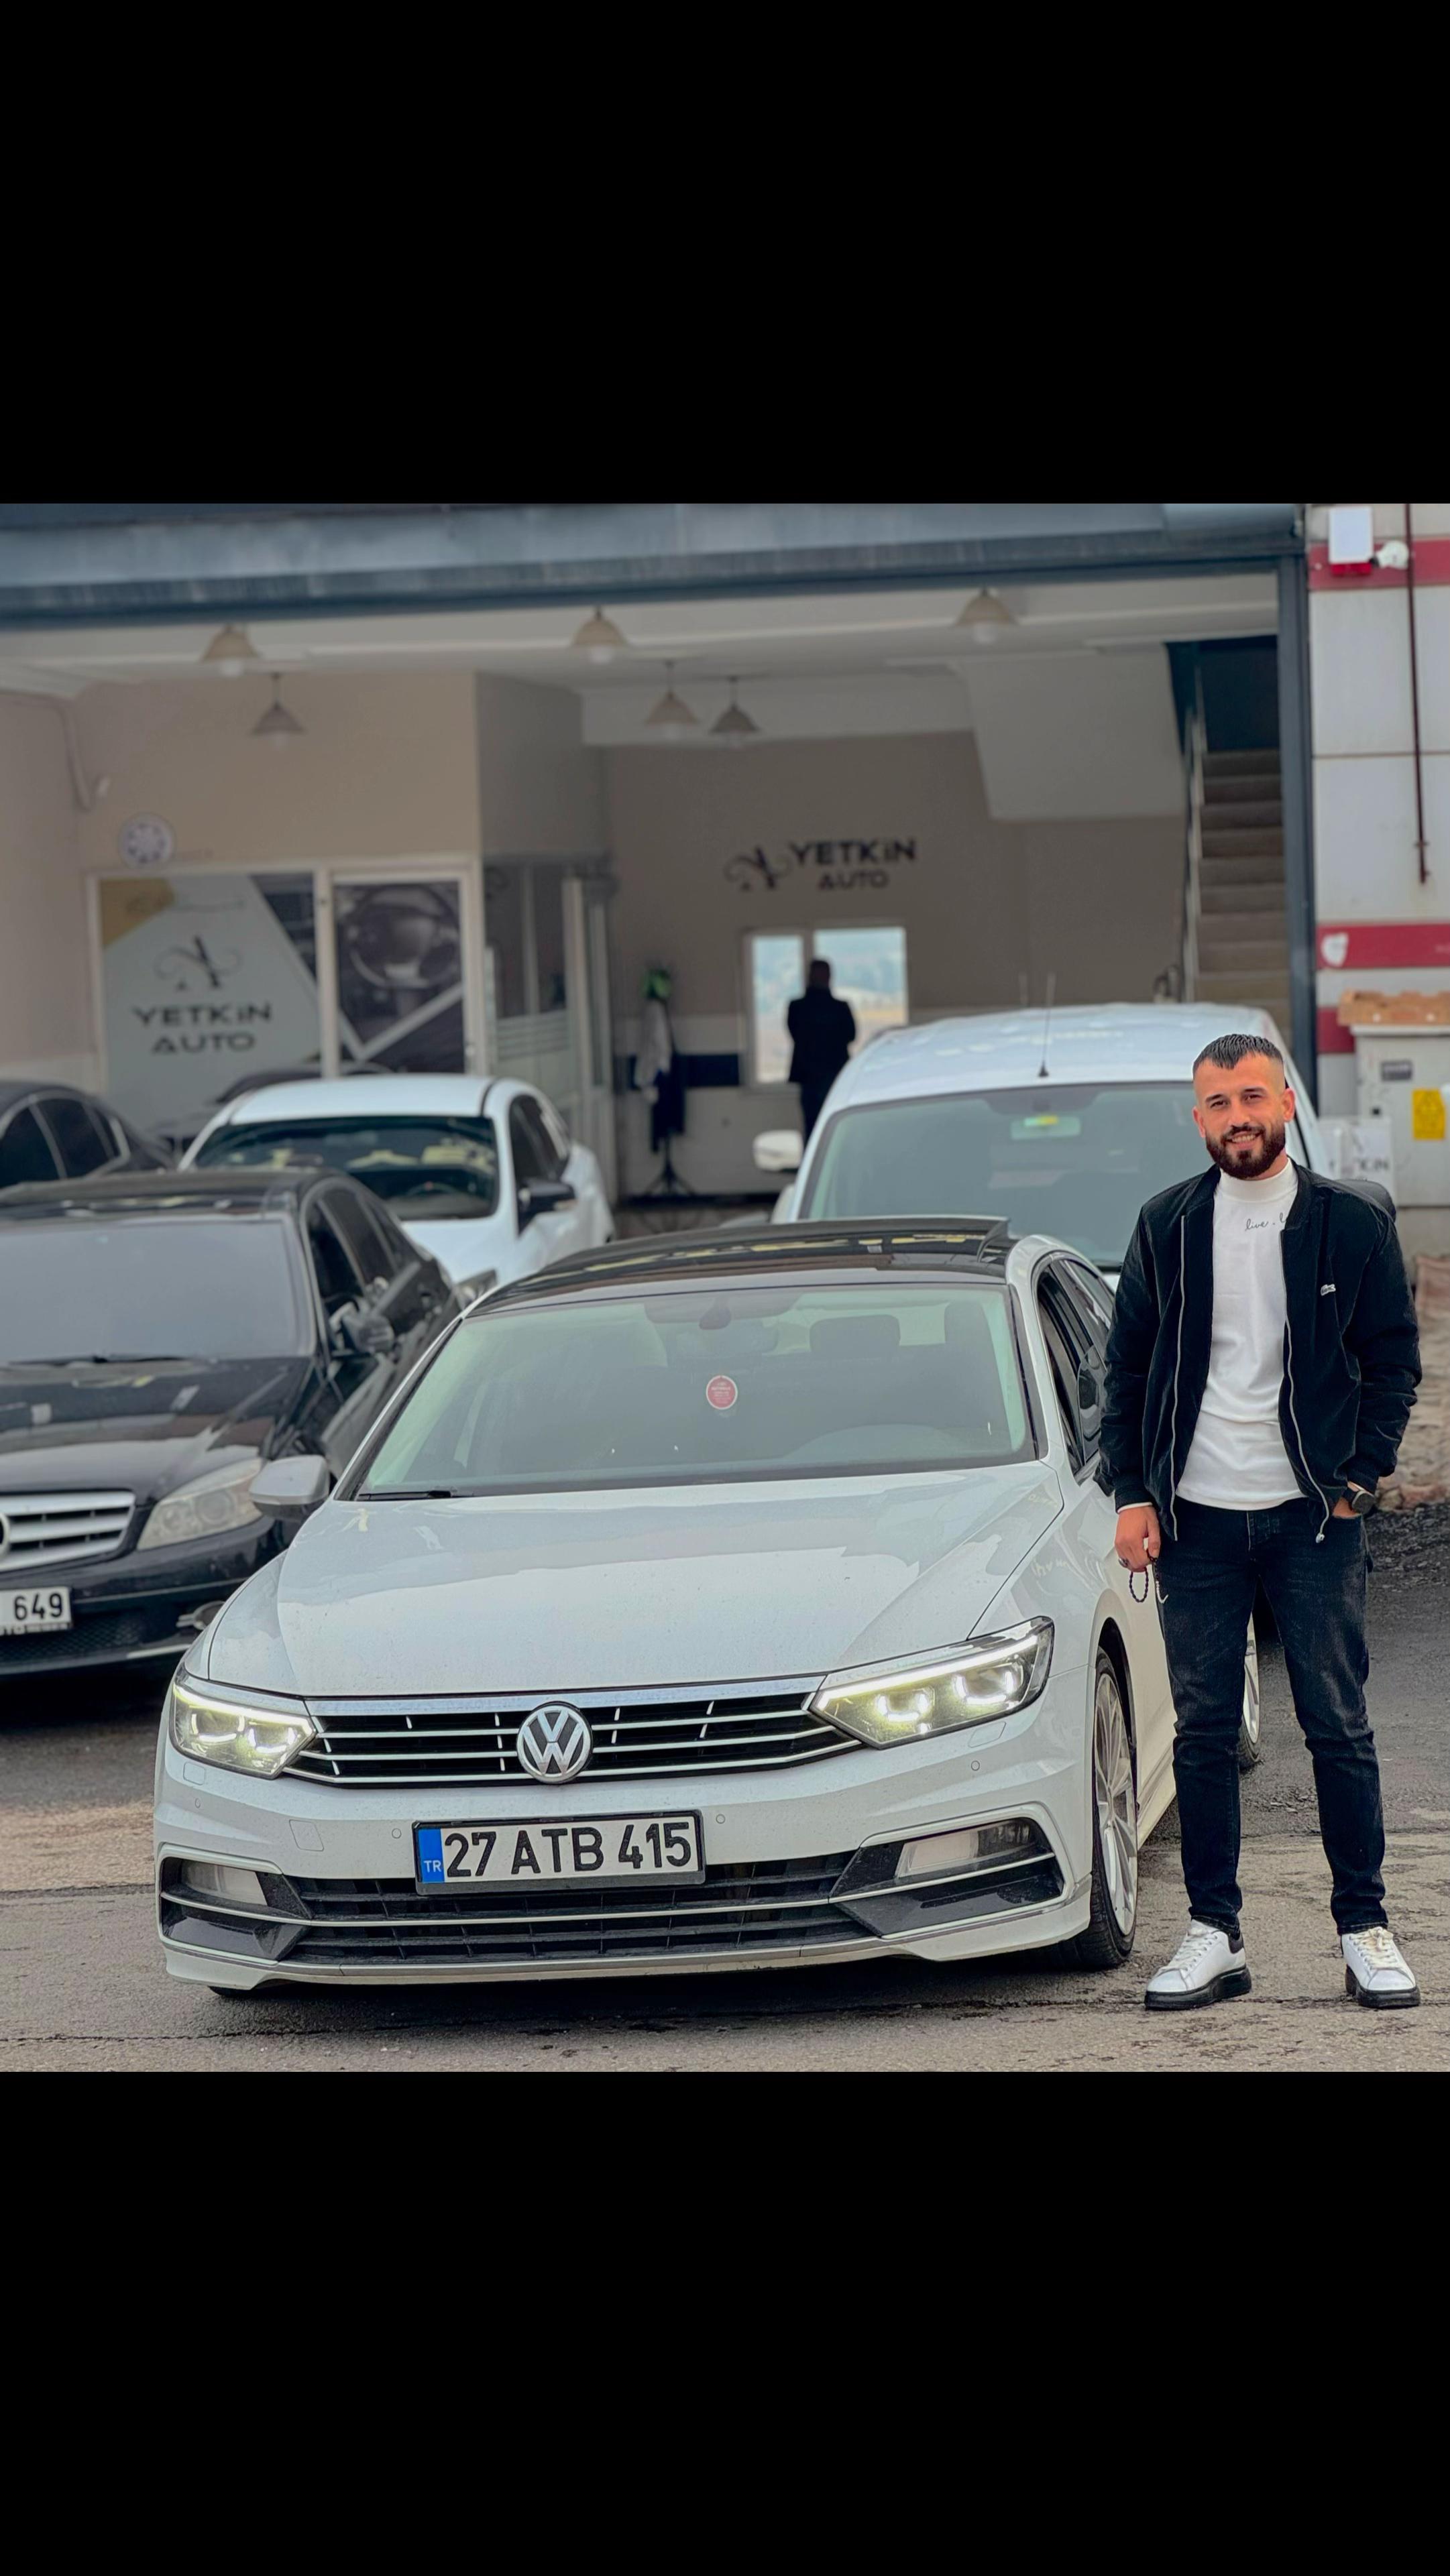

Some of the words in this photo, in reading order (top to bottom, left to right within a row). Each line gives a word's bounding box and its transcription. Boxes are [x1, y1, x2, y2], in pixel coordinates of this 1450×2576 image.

[818, 870, 889, 888] AUTO
[152, 1033, 256, 1055] AUTO
[14, 1593, 62, 1621] 649
[423, 1859, 442, 1873] TR
[445, 1832, 497, 1878] 27
[511, 1827, 604, 1875] ATB
[618, 1821, 691, 1870] 415
